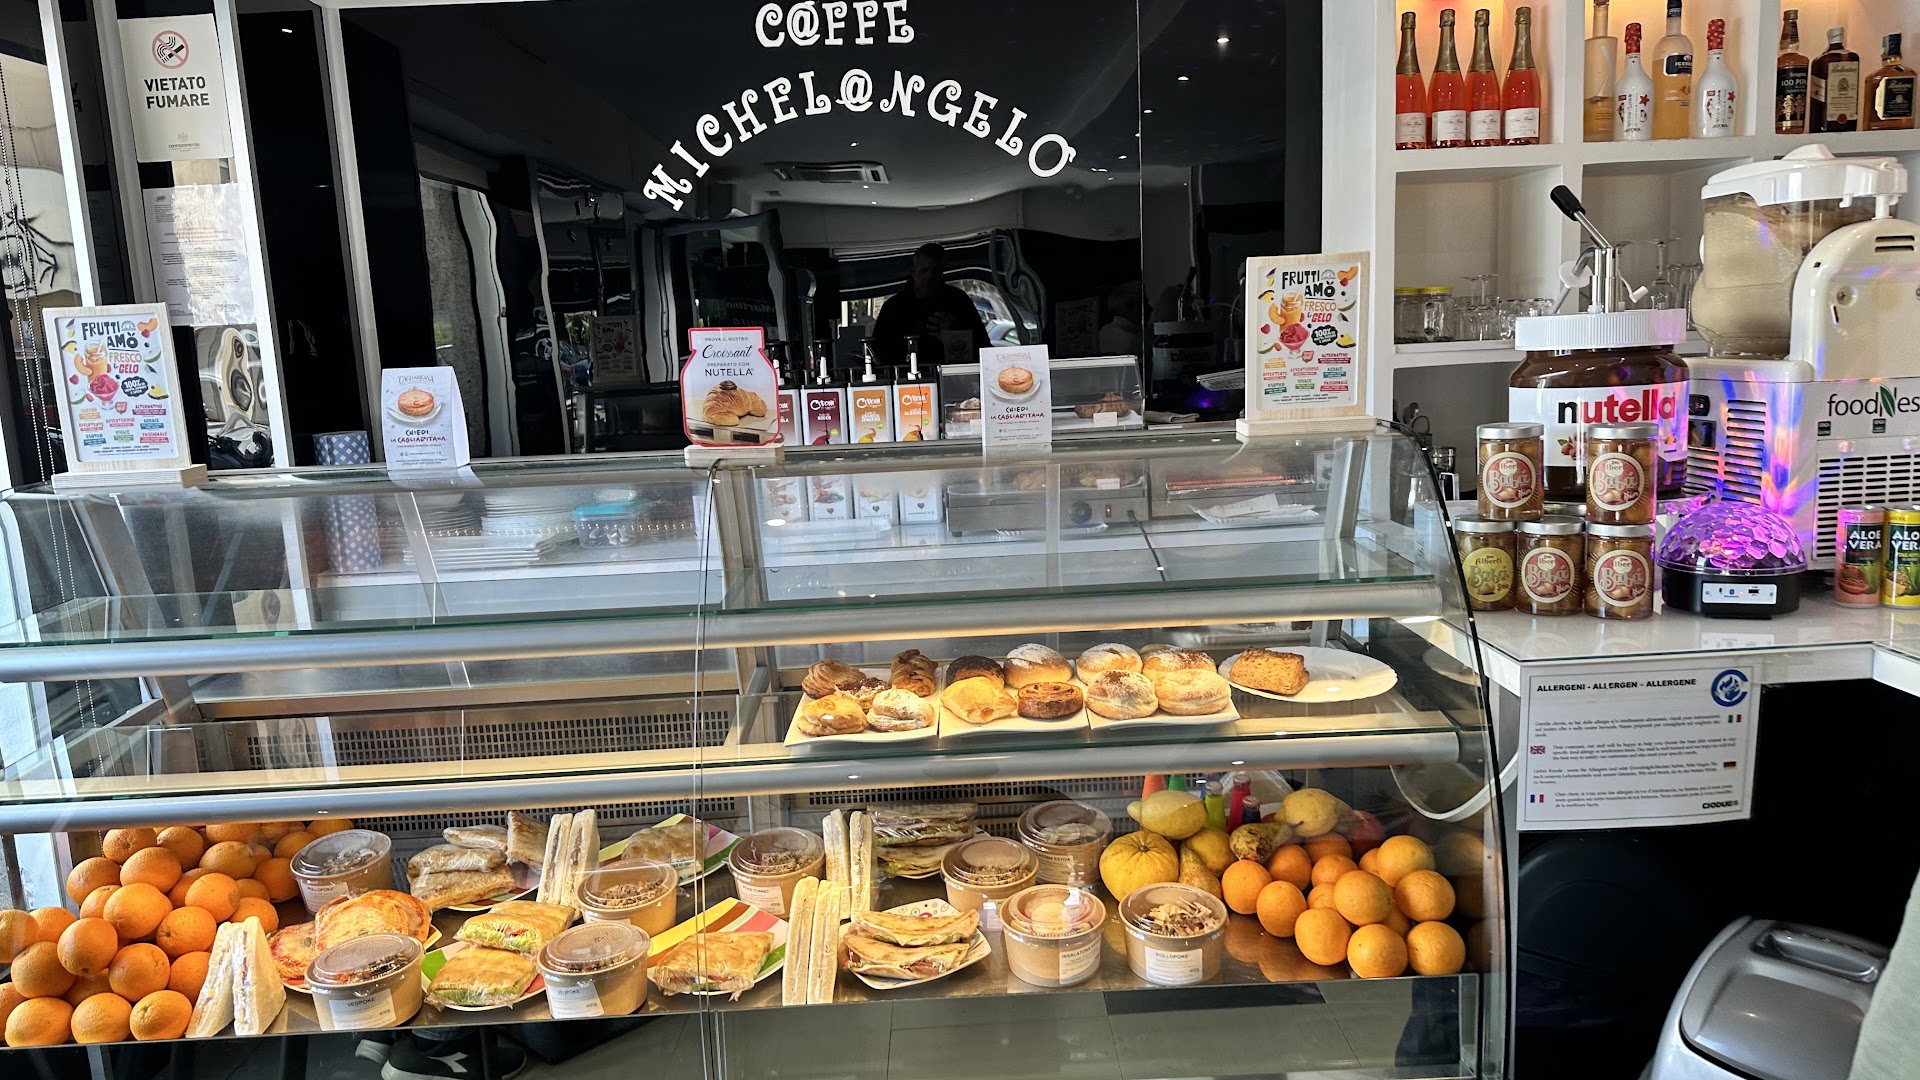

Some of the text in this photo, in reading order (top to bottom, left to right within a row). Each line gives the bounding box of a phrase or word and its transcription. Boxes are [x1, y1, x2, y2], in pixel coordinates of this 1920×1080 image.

[144, 76, 206, 92] VIETATO
[146, 93, 210, 109] FUMARE
[1282, 270, 1320, 289] FRUTTI
[1304, 301, 1337, 312] FRESCO
[1312, 313, 1333, 323] GELO
[81, 321, 120, 340] FRUTTI
[702, 344, 753, 359] Croissant
[109, 352, 142, 363] FRESCO
[119, 364, 139, 374] GELO
[1006, 406, 1029, 414] CHIEDI
[1558, 388, 1676, 424] nutella
[405, 429, 429, 437] CHIEDI
[1849, 530, 1882, 540] ALOE
[1848, 540, 1882, 550] VERA
[1537, 679, 1696, 692] ALLERGENI ALLERGEN ALLERGENE
[379, 1008, 391, 1016] 400g
